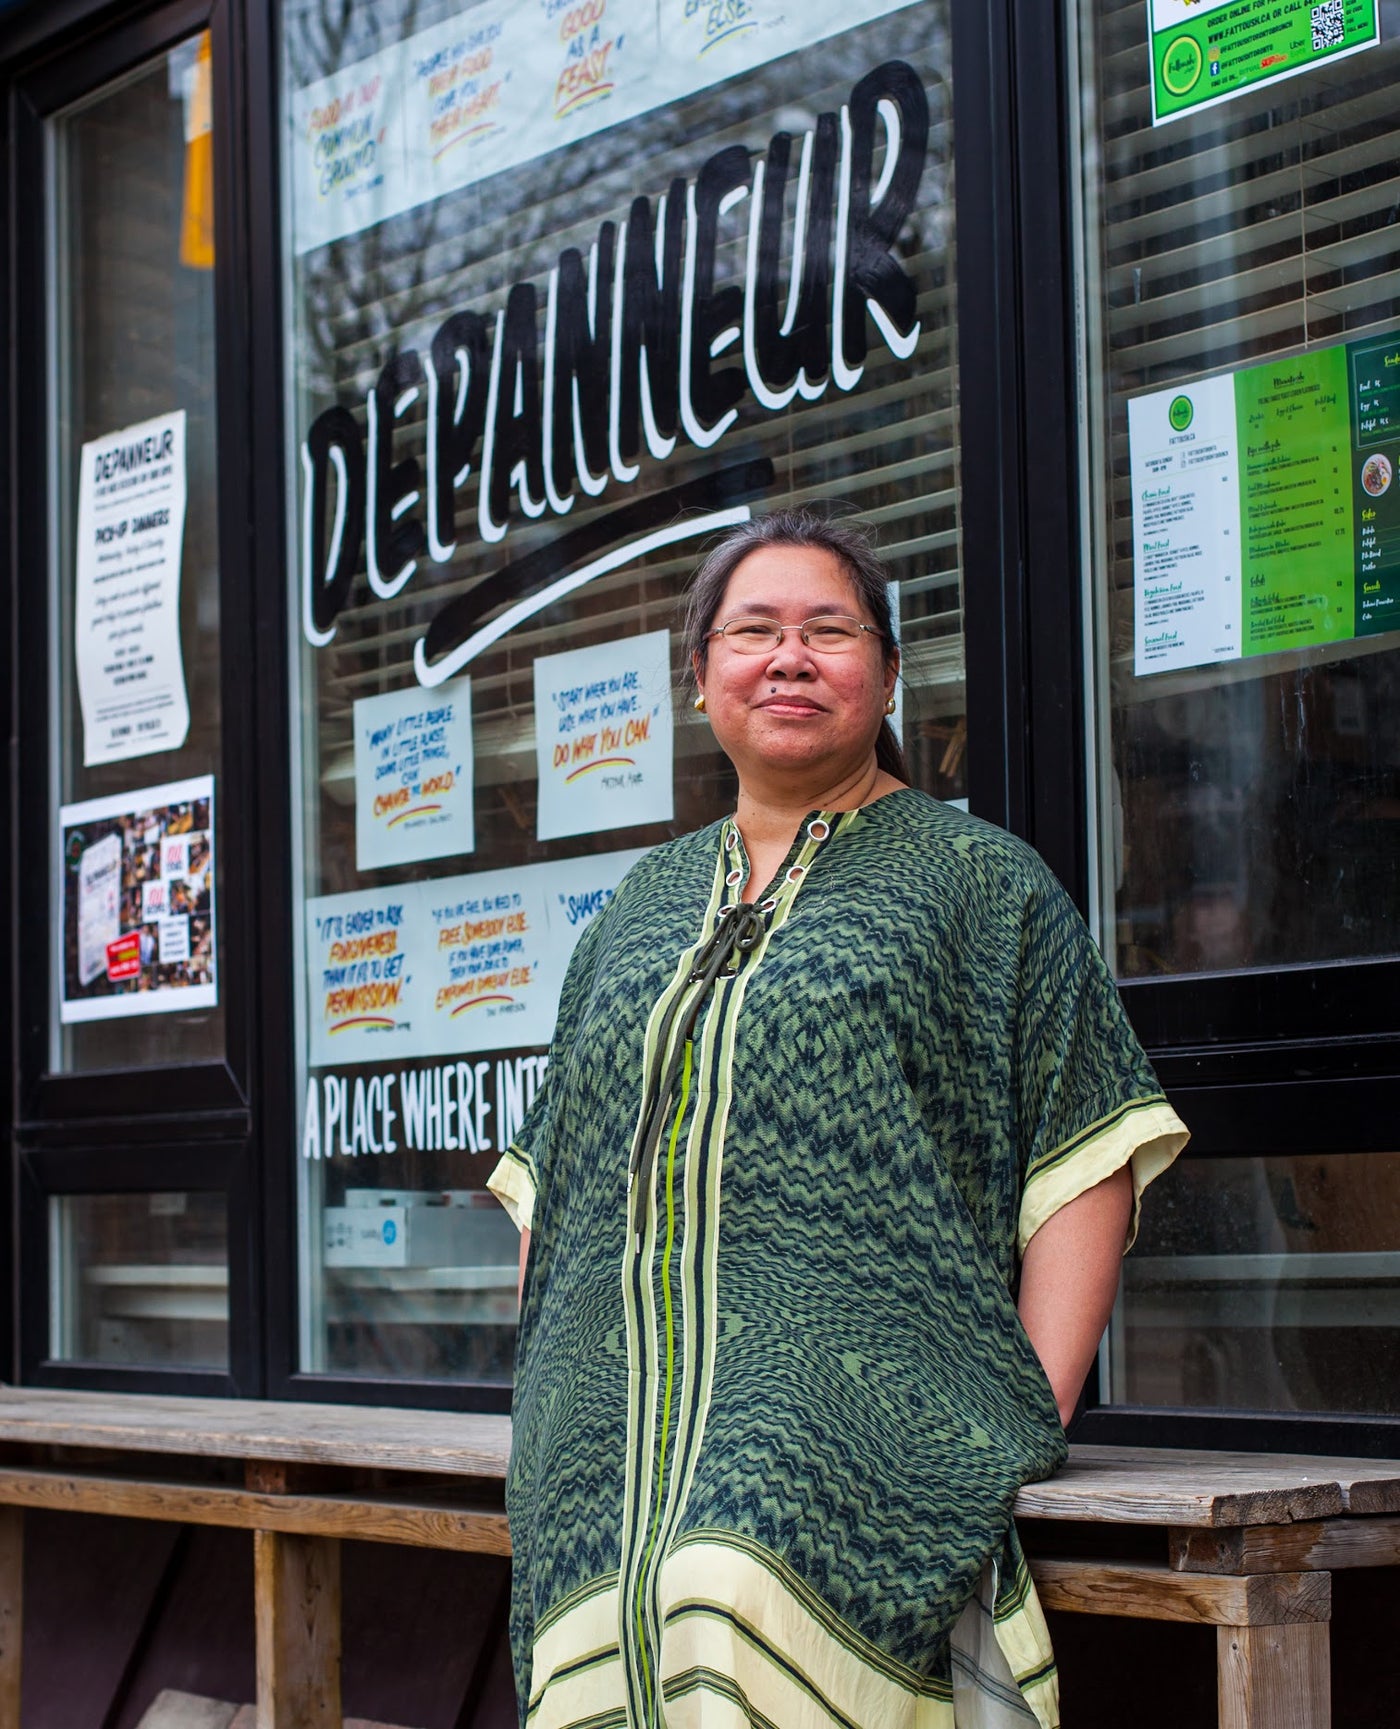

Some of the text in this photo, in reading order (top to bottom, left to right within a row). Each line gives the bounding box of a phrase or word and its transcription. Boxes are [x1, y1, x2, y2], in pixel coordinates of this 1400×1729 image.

[1207, 13, 1227, 28] ORDER
[1229, 4, 1251, 19] ONLINE
[1208, 12, 1271, 44] WWW.FATTOUSH.CA
[1272, 8, 1282, 19] OR
[1283, 1, 1302, 15] CALL
[566, 23, 601, 62] AS A
[1289, 39, 1306, 50] Uber
[302, 60, 929, 646] DEPANNEUR
[95, 430, 173, 483] DEPANNEUR
[585, 681, 607, 701] WHERE
[607, 676, 622, 694] YOU
[558, 712, 575, 733] USE
[578, 707, 598, 724] WHAT
[600, 701, 616, 720] YOU
[552, 743, 570, 769] DO
[571, 732, 599, 764] WHAT
[600, 725, 622, 756] YOU
[438, 925, 462, 951] FREE
[370, 959, 382, 980] TO
[383, 952, 405, 979] GET
[302, 1055, 550, 1161] A PLACE WHERE INT
